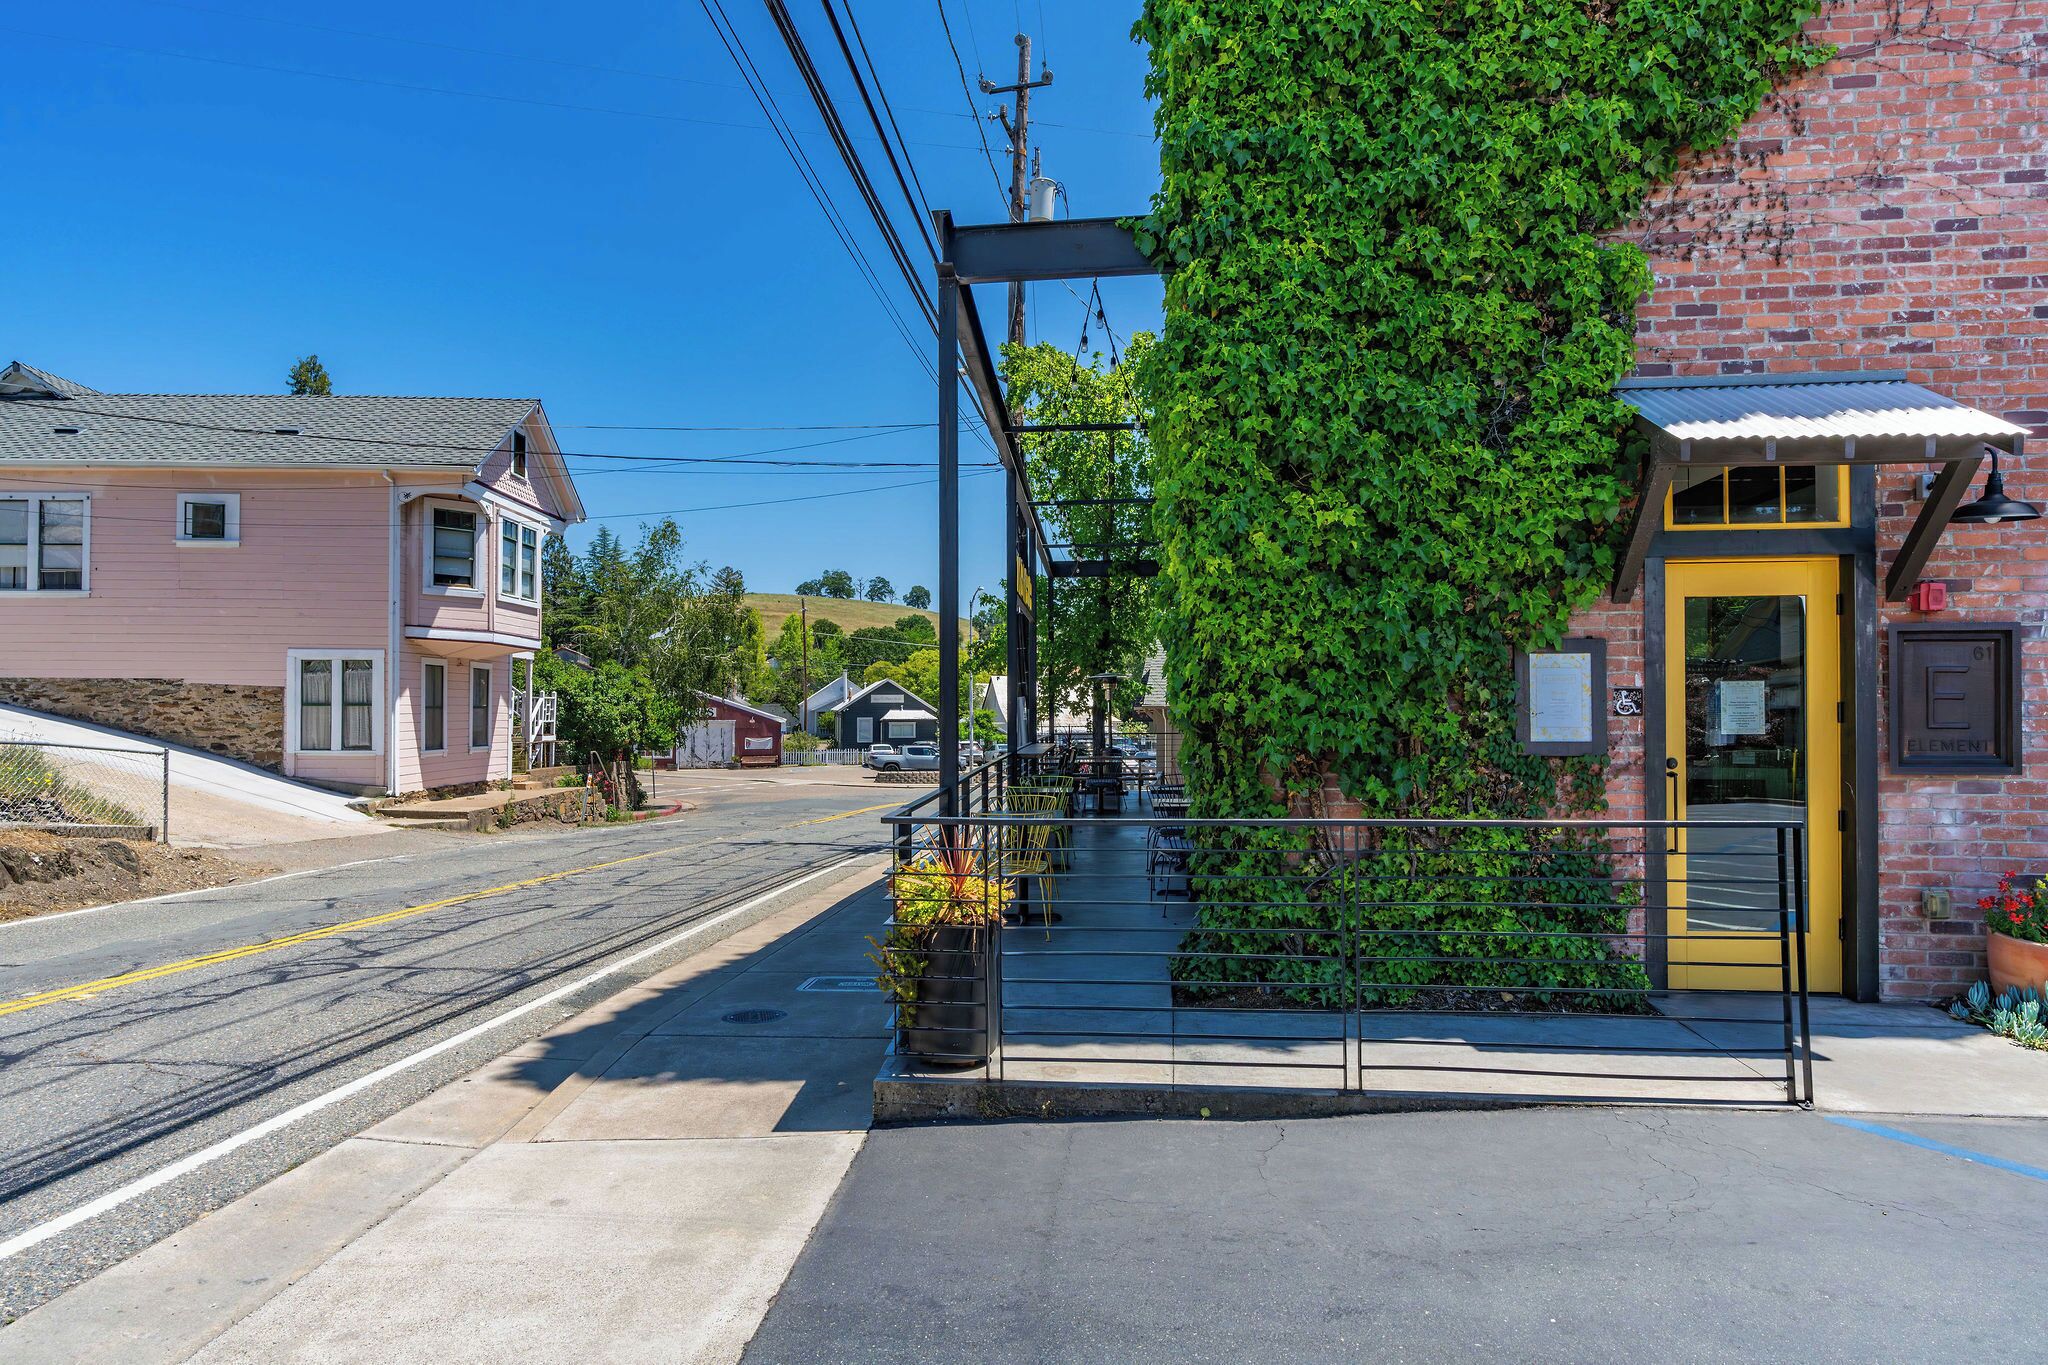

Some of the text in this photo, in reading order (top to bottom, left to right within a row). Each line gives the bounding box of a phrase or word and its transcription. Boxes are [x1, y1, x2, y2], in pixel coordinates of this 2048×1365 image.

[1973, 645, 1992, 661] 61
[1926, 666, 1970, 729] E
[1907, 739, 1991, 752] ELEMENT
